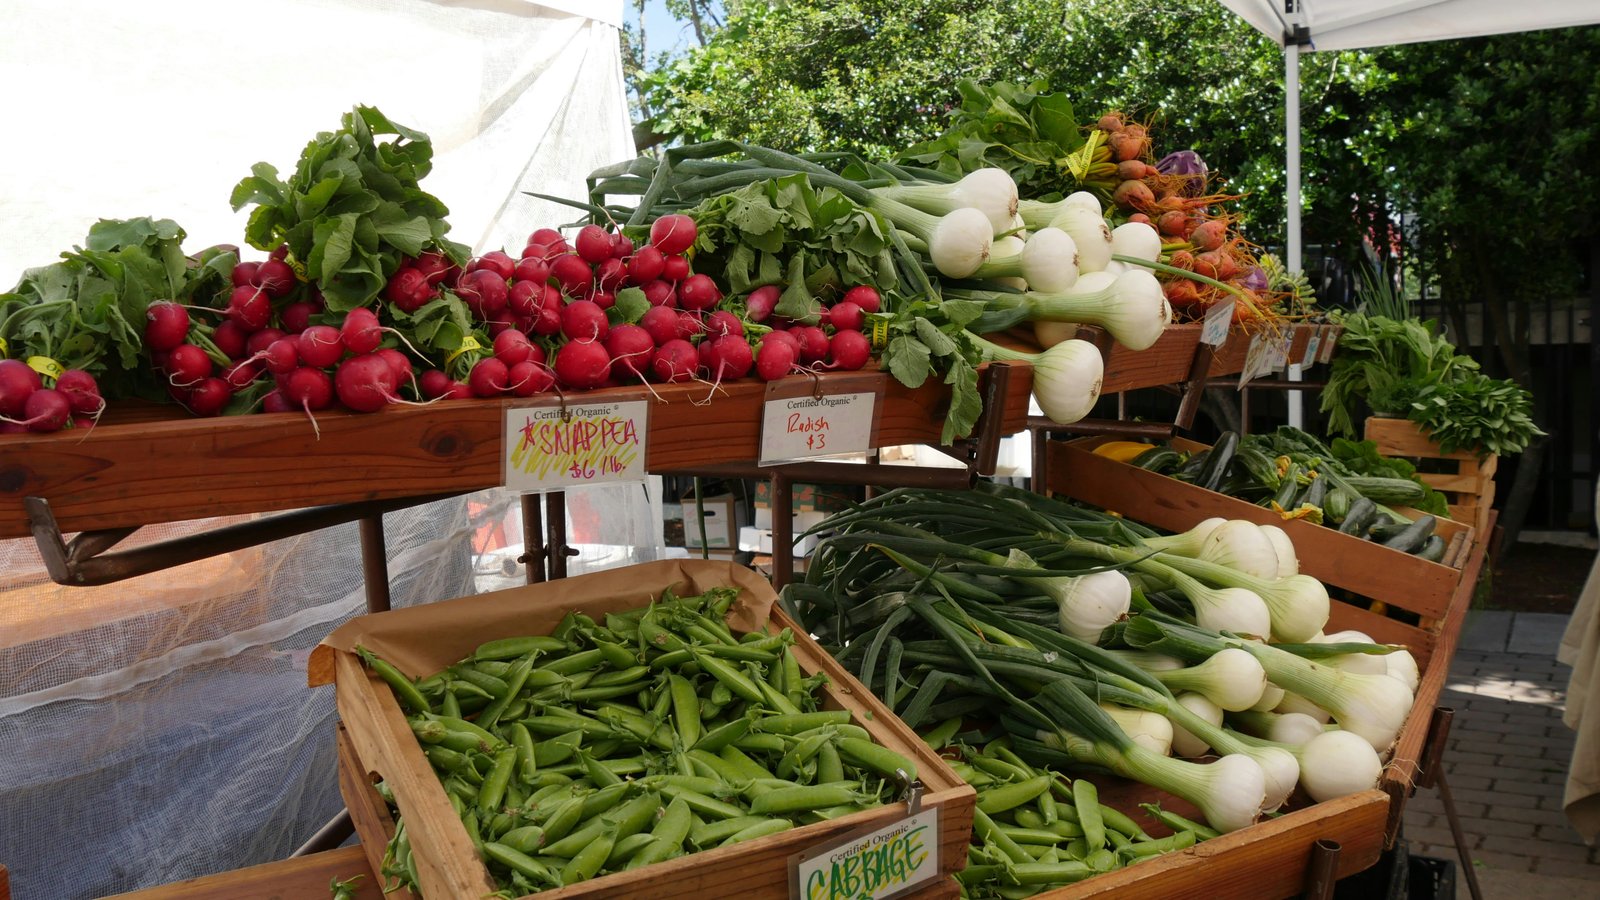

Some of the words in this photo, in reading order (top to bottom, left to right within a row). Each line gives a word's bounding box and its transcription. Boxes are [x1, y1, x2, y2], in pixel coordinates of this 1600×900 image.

[576, 406, 611, 417] Organic
[787, 399, 819, 409] Certified
[821, 397, 850, 408] Organic
[787, 413, 829, 433] Radish
[807, 433, 825, 450] $3
[569, 460, 595, 479] $6
[830, 840, 870, 864] Certified
[873, 824, 909, 845] Organic
[806, 825, 928, 900] CABBAGE
